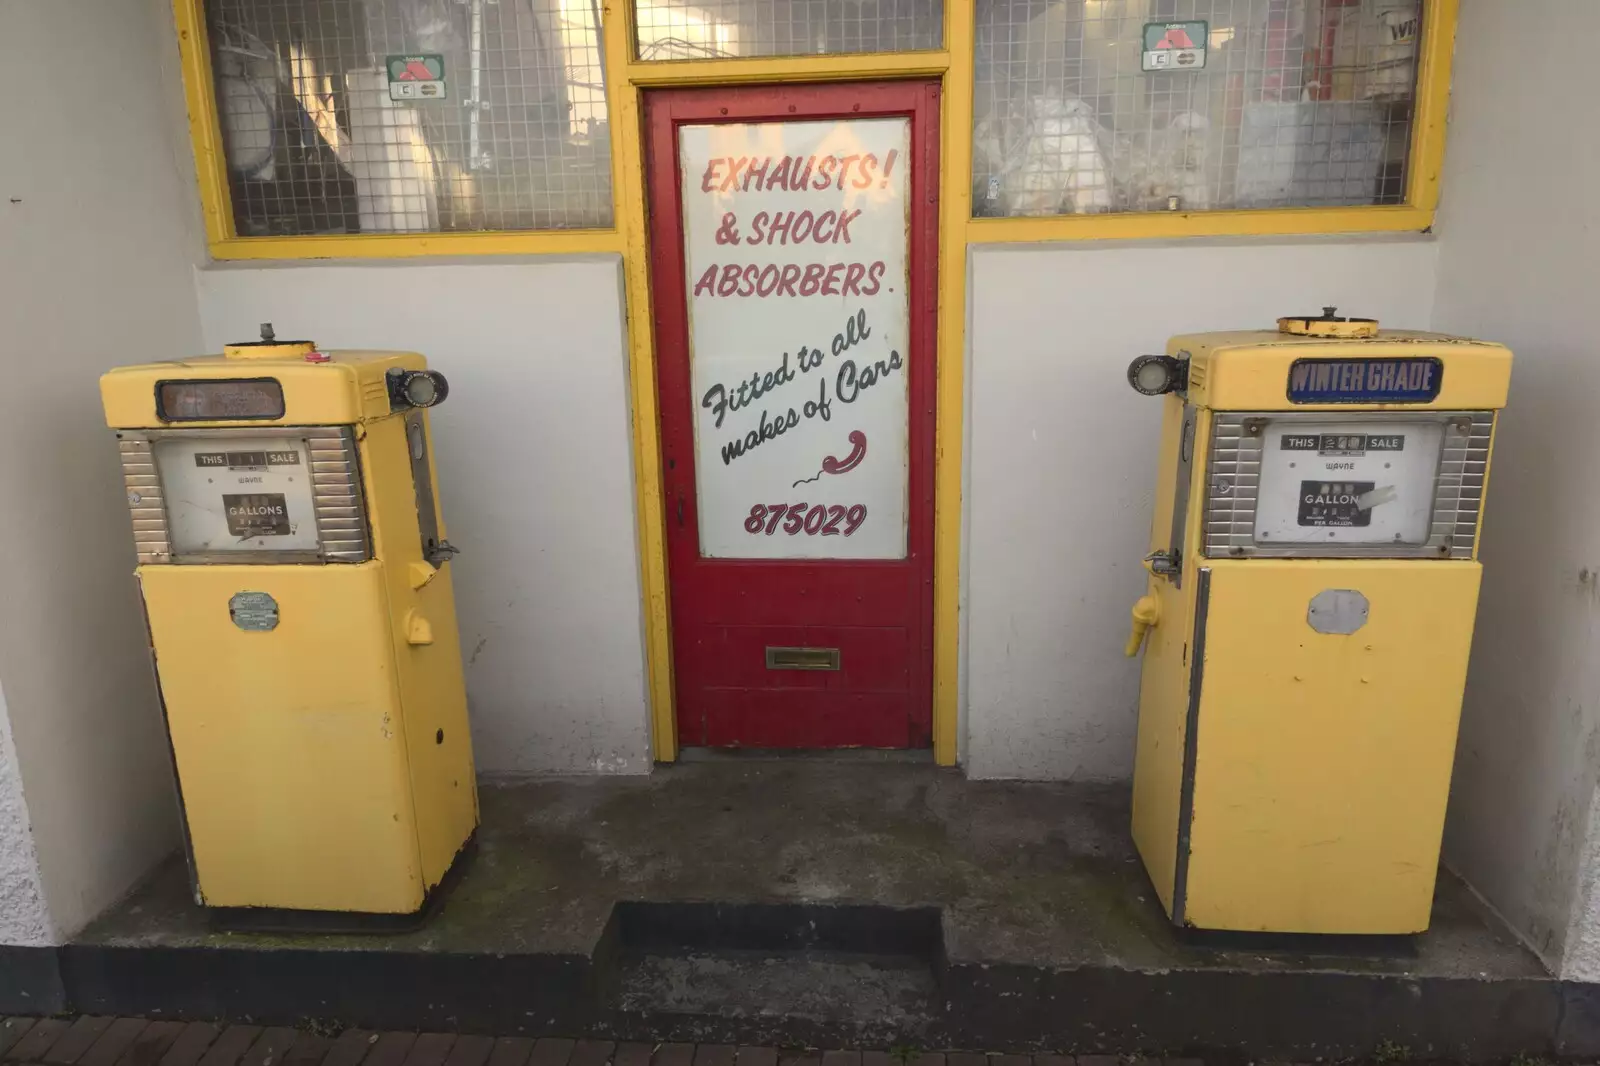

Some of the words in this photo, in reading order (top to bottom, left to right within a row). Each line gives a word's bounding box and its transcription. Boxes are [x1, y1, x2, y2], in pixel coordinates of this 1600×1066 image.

[701, 149, 898, 193] EXHAUSTS!
[715, 211, 741, 245] &
[746, 209, 862, 245] SHOCK
[694, 261, 894, 297] ABSORBERS.
[702, 352, 795, 429] Fitted
[797, 346, 824, 373] to
[832, 308, 871, 356] all
[1292, 362, 1365, 391] WINTER
[1367, 362, 1433, 391] GRADE
[721, 408, 800, 465] makes
[803, 377, 832, 421] of
[836, 350, 903, 403] Cars
[1289, 438, 1314, 447] THIS
[1371, 439, 1398, 447] SALE
[202, 456, 223, 464] THIS
[271, 454, 294, 462] SALE
[1325, 462, 1355, 470] WAYNE
[229, 506, 283, 515] GALLONS
[1305, 495, 1359, 504] GALLON
[744, 502, 867, 537] 875029
